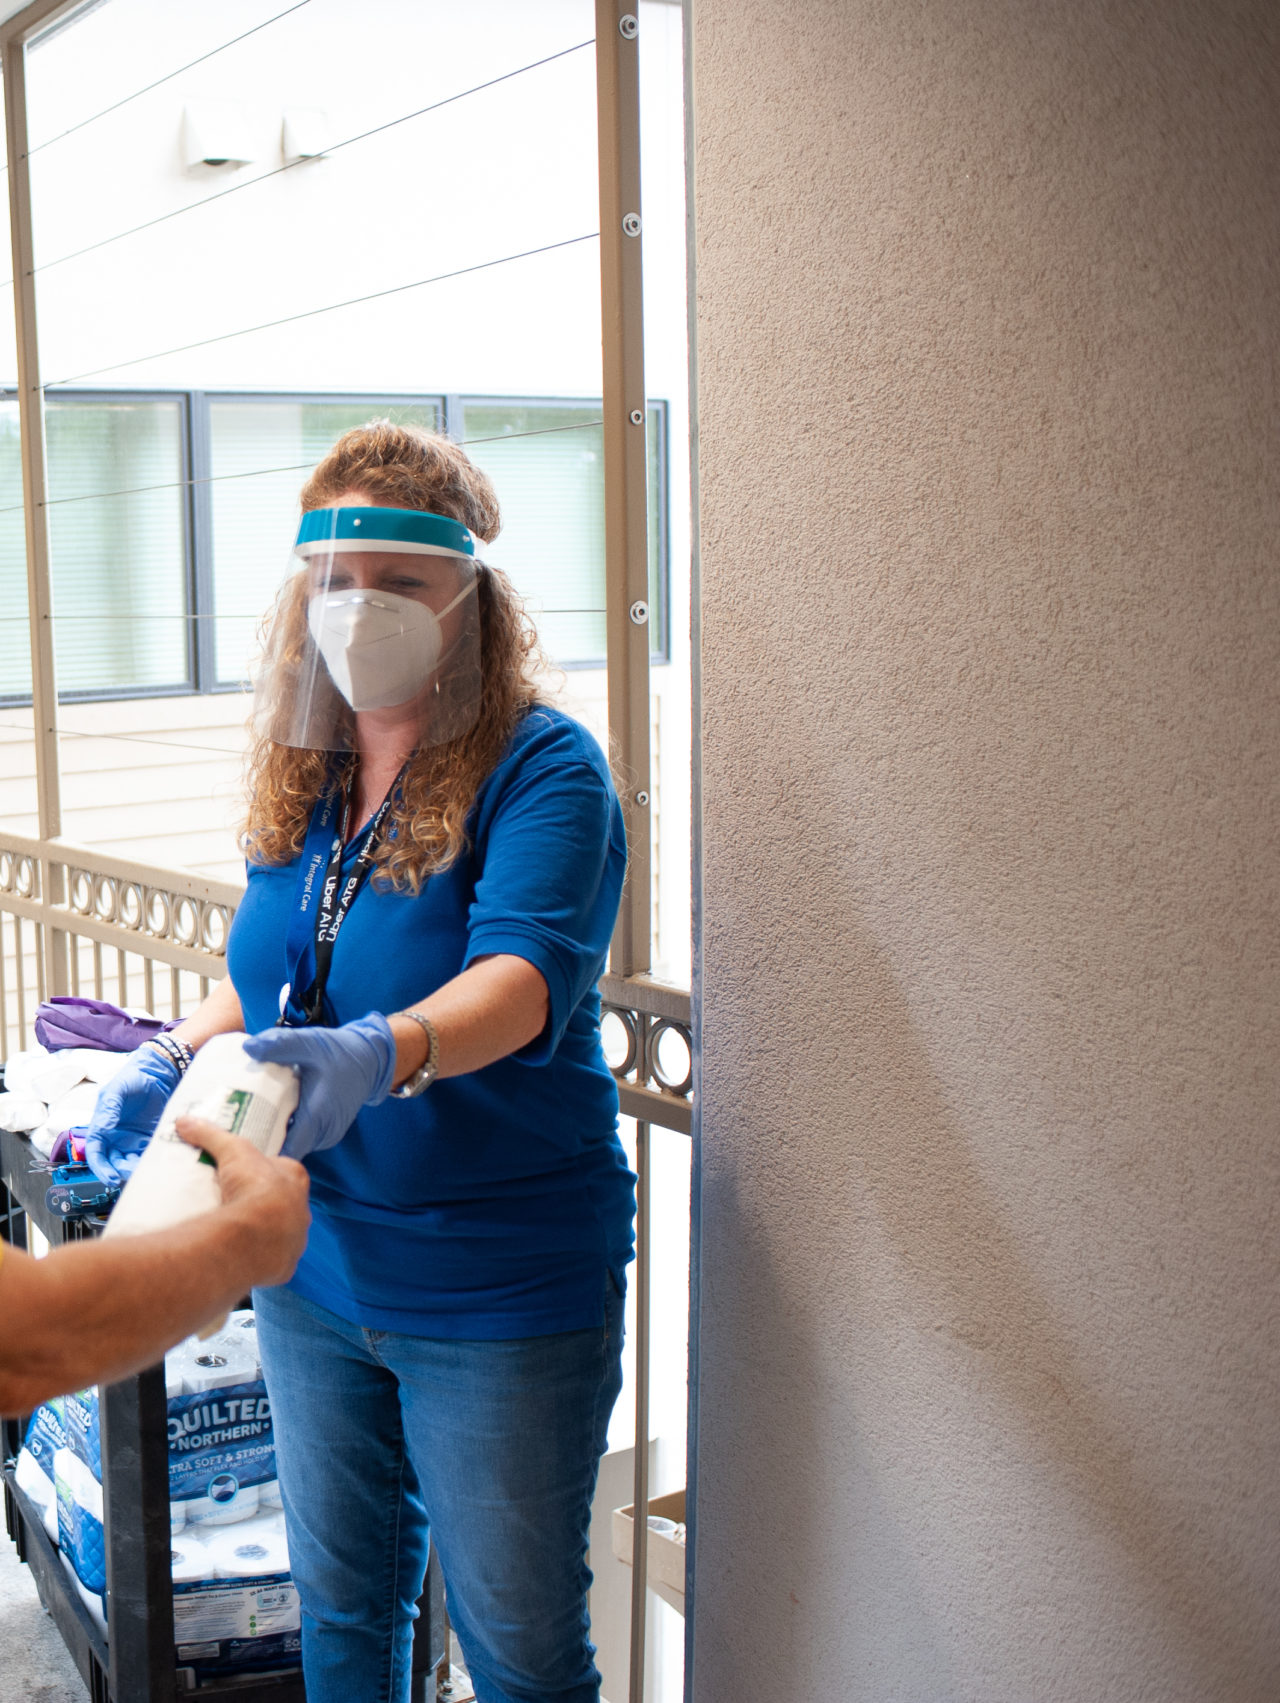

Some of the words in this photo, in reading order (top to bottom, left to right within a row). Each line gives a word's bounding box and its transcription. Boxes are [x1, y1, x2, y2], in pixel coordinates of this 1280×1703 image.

[304, 863, 318, 893] Integral
[322, 876, 336, 910] Uber
[300, 894, 311, 912] Care
[326, 907, 345, 942] Uber
[341, 877, 358, 907] ATG
[167, 1398, 272, 1440] QUILTED
[178, 1421, 262, 1451] NORTHERN
[195, 1454, 223, 1469] SOFT
[225, 1453, 233, 1462] &
